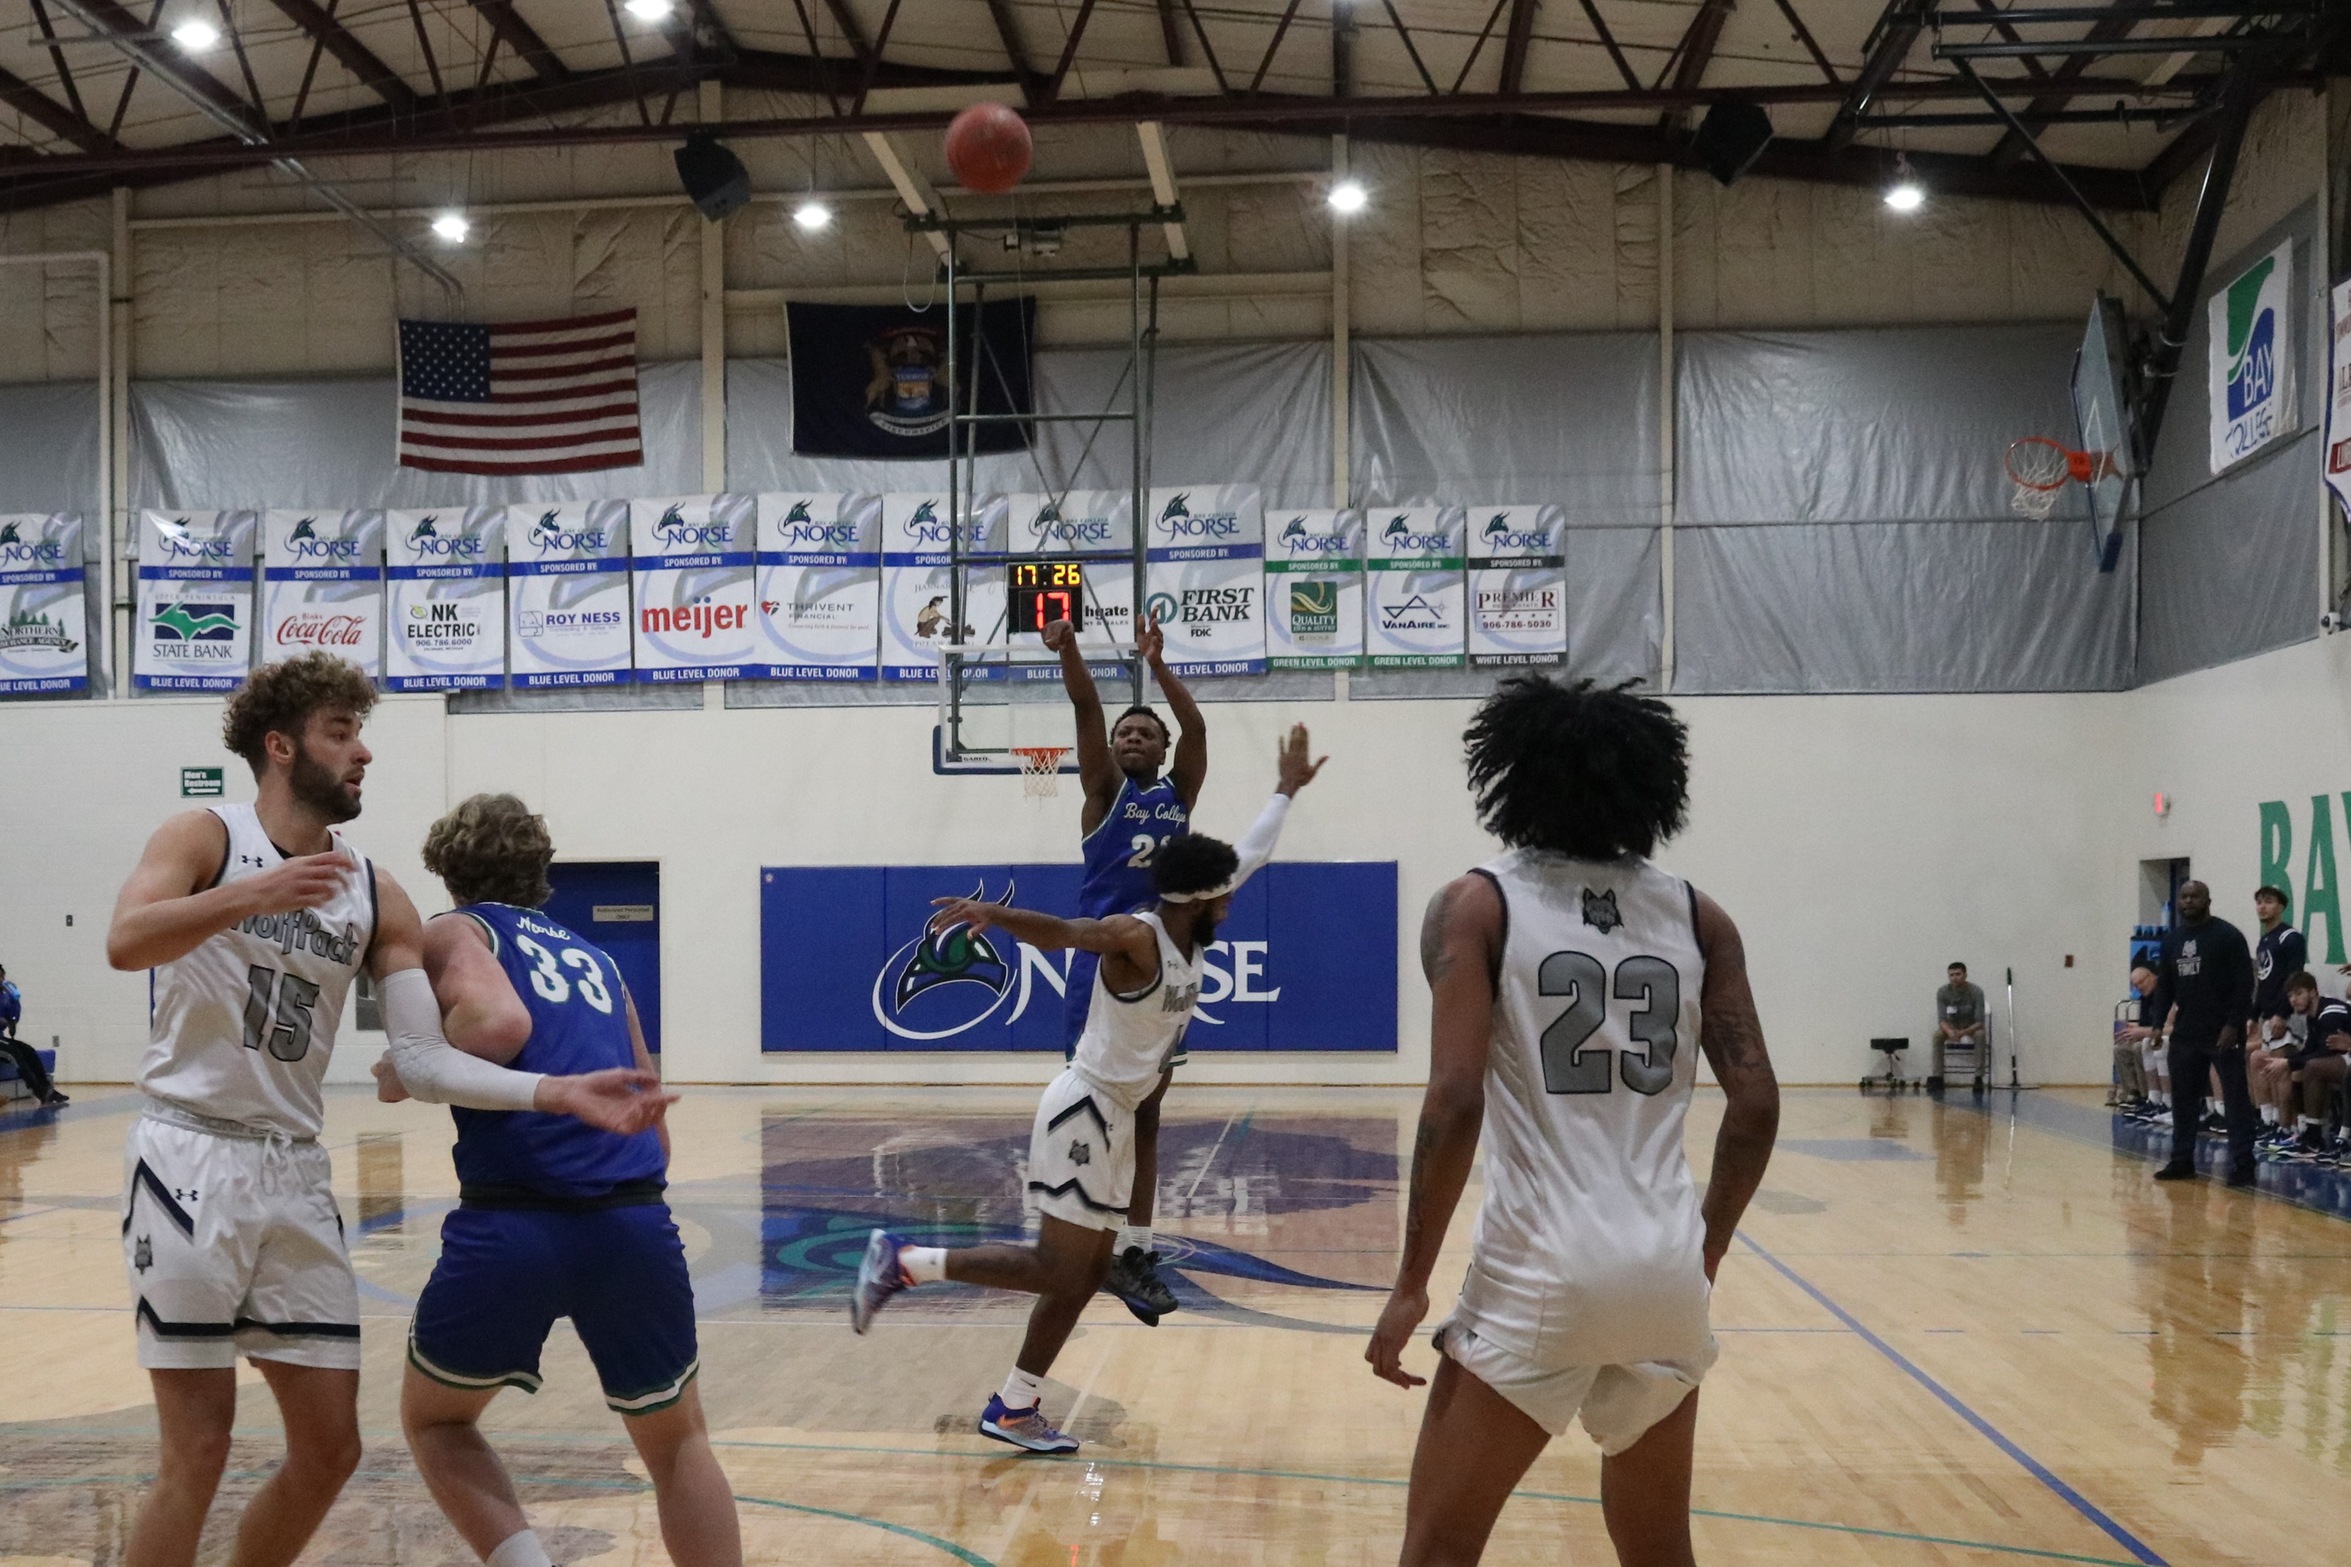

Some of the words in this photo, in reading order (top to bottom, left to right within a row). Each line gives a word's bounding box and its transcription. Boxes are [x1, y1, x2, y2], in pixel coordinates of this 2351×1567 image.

[2243, 343, 2274, 408] BAY
[790, 525, 859, 546] NORSE
[1042, 523, 1112, 546] NORSE
[1170, 517, 1240, 541] NORSE
[541, 532, 608, 556] NORSE
[665, 526, 733, 550] NORSE
[1290, 536, 1349, 555] NORSE
[1391, 535, 1451, 554] NORSE
[1492, 533, 1552, 552] NORSE
[3, 544, 65, 567] NORSE
[169, 541, 234, 561] NORSE
[297, 540, 361, 562] NORSE
[417, 538, 485, 561] NORSE
[1168, 549, 1216, 560] SPONSORED
[540, 562, 585, 573] SPONSORED
[664, 557, 709, 567] SPONSORED
[789, 555, 835, 564] SPONSORED
[915, 555, 951, 565] SPONSOR
[168, 569, 211, 578] SPONSORED
[295, 570, 338, 579] SPONSORED
[416, 568, 461, 577] SPONSORED
[1016, 564, 1081, 587] 17:26
[1180, 587, 1255, 606] FIRST
[1478, 590, 1555, 610] PREMIER
[432, 604, 458, 621] NK
[786, 603, 854, 612] THRIVENT
[1036, 591, 1070, 630] 17
[1181, 605, 1251, 623] BANK
[546, 614, 576, 625] ROY
[581, 612, 620, 623] NESS
[642, 596, 748, 639] meijer
[1292, 615, 1337, 627] QUALITY
[1482, 620, 1552, 630] 906-786-5030
[1, 626, 60, 639] NORTHERN
[277, 615, 367, 646] Coca-Cola
[408, 623, 475, 638] ELECTRIC
[1190, 629, 1212, 637] FDIC
[153, 643, 190, 658] STATE
[194, 644, 233, 659] BANK
[1475, 656, 1501, 665] WHITE
[1503, 655, 1529, 664] LEVEL
[1530, 653, 1559, 663] DONOR
[1184, 664, 1212, 674] LEVEL
[1215, 662, 1249, 673] DONOR
[1273, 658, 1300, 667] GREEN
[1301, 657, 1325, 666] LEVEL
[1327, 656, 1356, 666] DONOR
[1374, 656, 1401, 665] GREEN
[1402, 656, 1427, 665] LEVEL
[1428, 655, 1458, 664] DONOR
[528, 675, 550, 685] BLUE
[553, 674, 580, 684] LEVEL
[583, 672, 615, 682] DONOR
[652, 670, 676, 680] BLUE
[678, 668, 705, 679] LEVEL
[707, 667, 740, 677] DONOR
[770, 667, 794, 676] BLUE
[796, 668, 824, 677] LEVEL
[826, 668, 859, 678] DONOR
[900, 668, 923, 678] BLUE
[1026, 668, 1051, 679] BLUE
[1090, 667, 1118, 678] ONOR
[13, 681, 38, 690] LEVEL
[40, 679, 71, 689] DONOR
[150, 677, 173, 686] BLUE
[174, 678, 200, 687] LEVEL
[202, 679, 233, 688] DONOR
[403, 679, 424, 687] BLUE
[426, 678, 450, 686] LEVEL
[454, 677, 486, 686] DONOR
[1123, 802, 1151, 825] Bay
[2258, 787, 2351, 965] BA
[516, 916, 571, 940] Norse
[516, 934, 613, 1015] 33
[1004, 940, 1281, 1026] NSE
[243, 963, 321, 1063] 15
[1538, 950, 1680, 1096] 23
